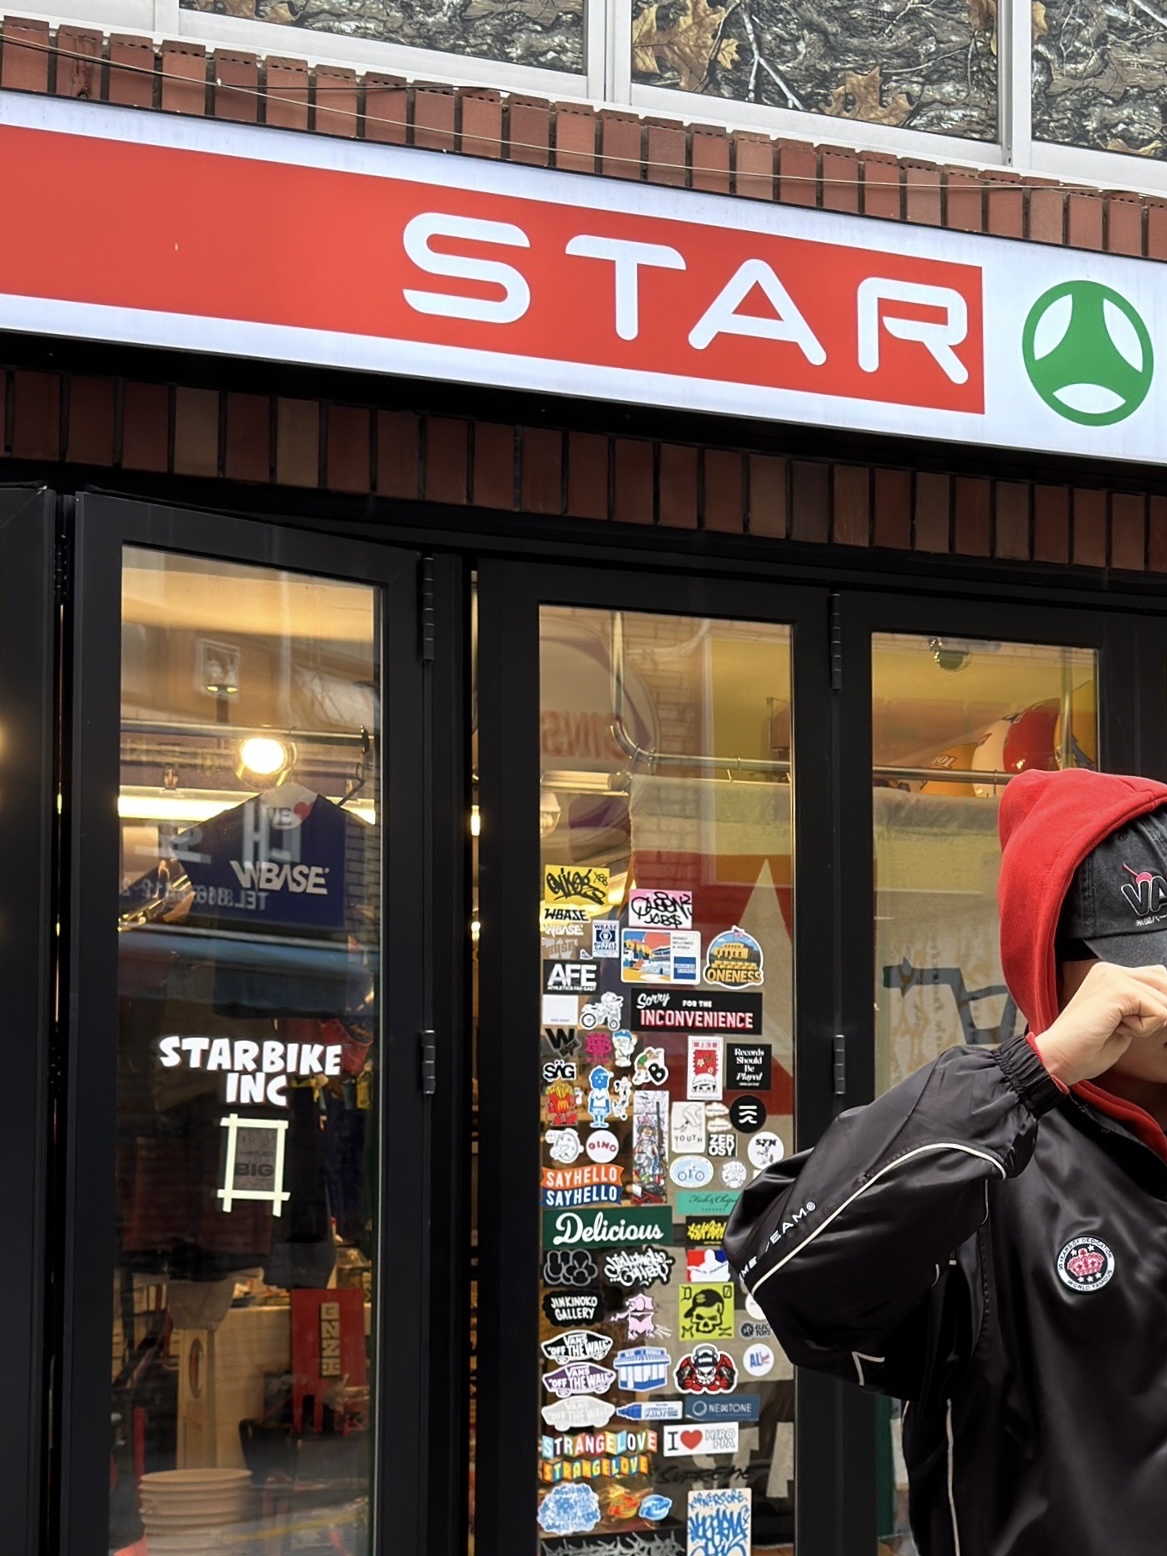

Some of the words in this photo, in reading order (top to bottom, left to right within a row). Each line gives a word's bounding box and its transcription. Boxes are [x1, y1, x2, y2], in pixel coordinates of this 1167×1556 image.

[402, 211, 970, 385] STAR
[547, 963, 597, 987] AFE
[706, 968, 761, 983] ONENESS
[636, 993, 670, 1009] Sorry
[640, 1009, 754, 1029] INCONVENIENCE
[159, 1036, 342, 1076] STARBIKE
[734, 1048, 764, 1057] Records
[736, 1056, 763, 1065] Should
[544, 1060, 576, 1079] SÄG
[744, 1064, 755, 1072] Be
[736, 1073, 763, 1082] Played
[226, 1072, 288, 1107] INC
[674, 1135, 703, 1143] YOUTH
[234, 1163, 274, 1177] BIG
[546, 1166, 617, 1187] SAYHELLO
[545, 1185, 617, 1207] SAYHELLO
[552, 1211, 664, 1246] Delicious
[550, 1296, 598, 1309] JINKINOKO
[554, 1307, 595, 1321] GALLERY
[564, 1365, 591, 1377] VANS
[569, 1375, 587, 1390] THE
[542, 1430, 657, 1459] STRANGELOVE
[667, 1431, 679, 1451] I
[543, 1455, 649, 1482] STRANGELOVE
